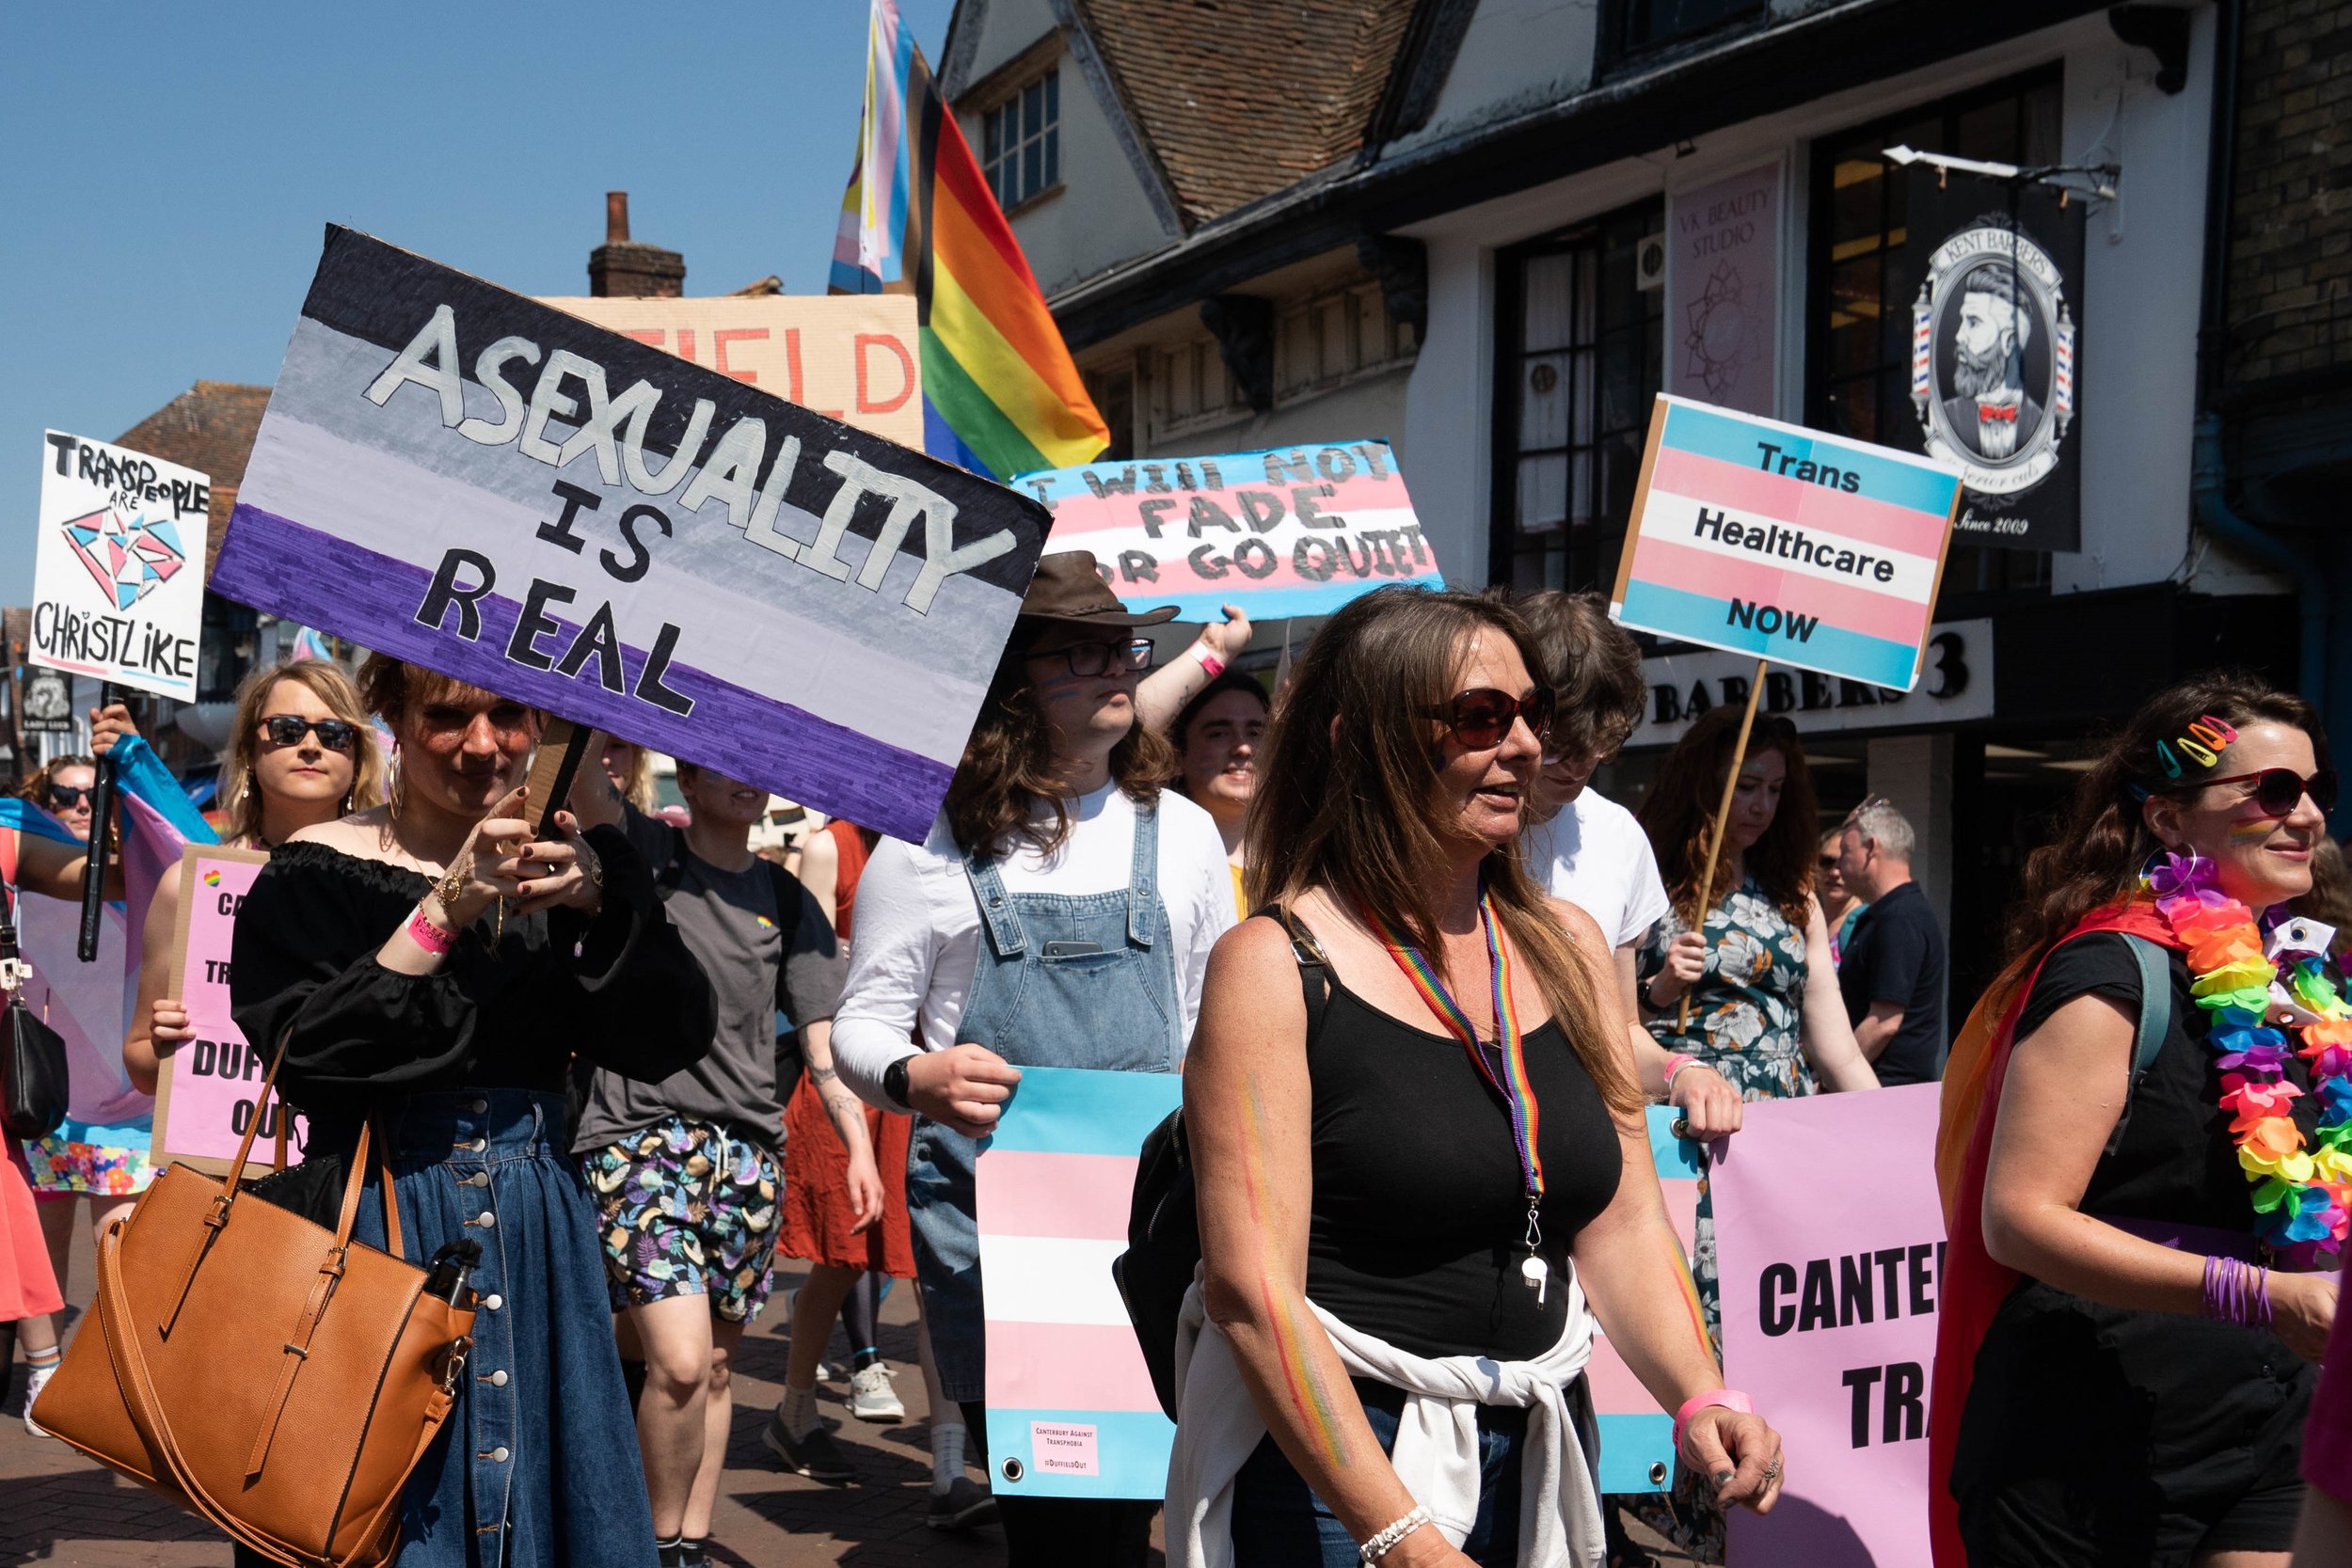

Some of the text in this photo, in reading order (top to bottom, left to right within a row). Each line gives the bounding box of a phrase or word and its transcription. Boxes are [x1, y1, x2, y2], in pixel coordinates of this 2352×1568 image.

[1708, 187, 1771, 227] BEAUTY
[1692, 221, 1755, 259] STUDIO
[1945, 230, 2048, 275] KENT BARBERS
[362, 304, 1017, 617] ASEXUALITY
[1026, 477, 1059, 511] I
[1263, 443, 1390, 486] NOT
[1756, 442, 1861, 494] Trans
[109, 490, 139, 514] ARE
[1138, 483, 1346, 539] FADE
[1954, 507, 2029, 535] Since 2009
[536, 479, 674, 584] IS
[1187, 537, 1279, 580] GO
[1293, 523, 1430, 582] QUIET
[1693, 507, 1895, 583] Healthcare
[415, 547, 696, 719] REAL
[1726, 597, 1819, 643] NOW
[1927, 631, 1969, 699] 3
[1758, 1241, 1947, 1338] CANTE
